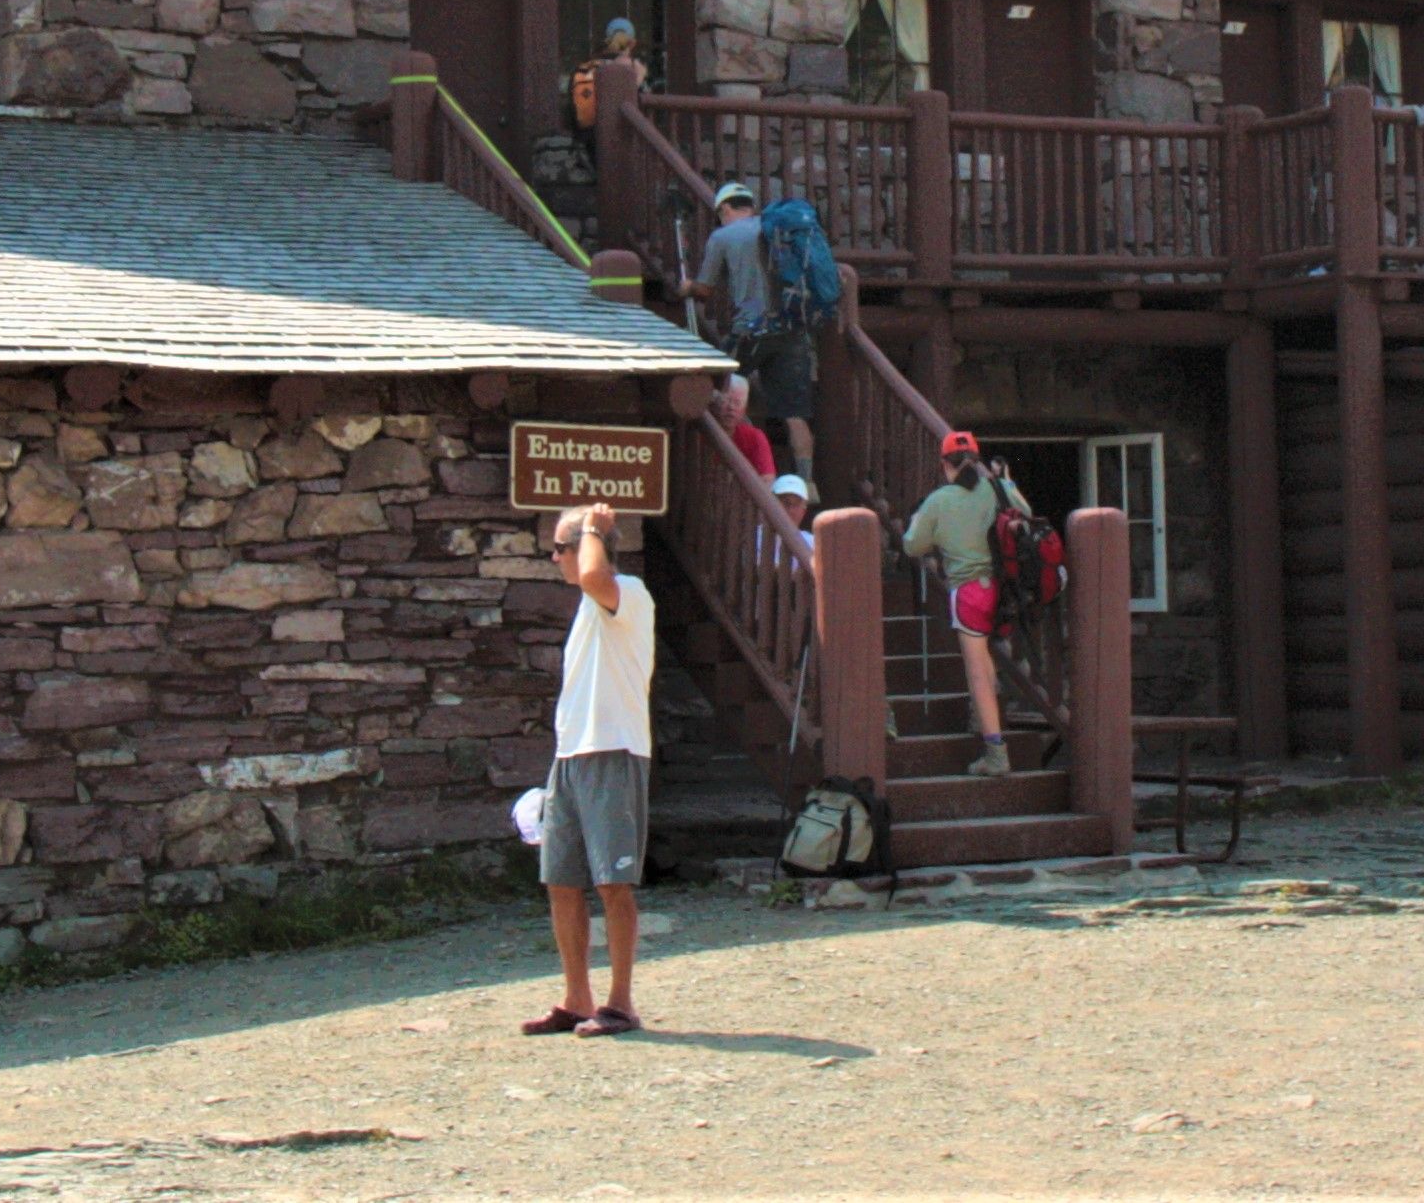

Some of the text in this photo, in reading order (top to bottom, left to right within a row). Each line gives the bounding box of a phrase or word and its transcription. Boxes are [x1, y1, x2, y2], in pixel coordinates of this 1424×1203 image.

[527, 434, 652, 464] Entrance
[533, 470, 645, 498] In Front
